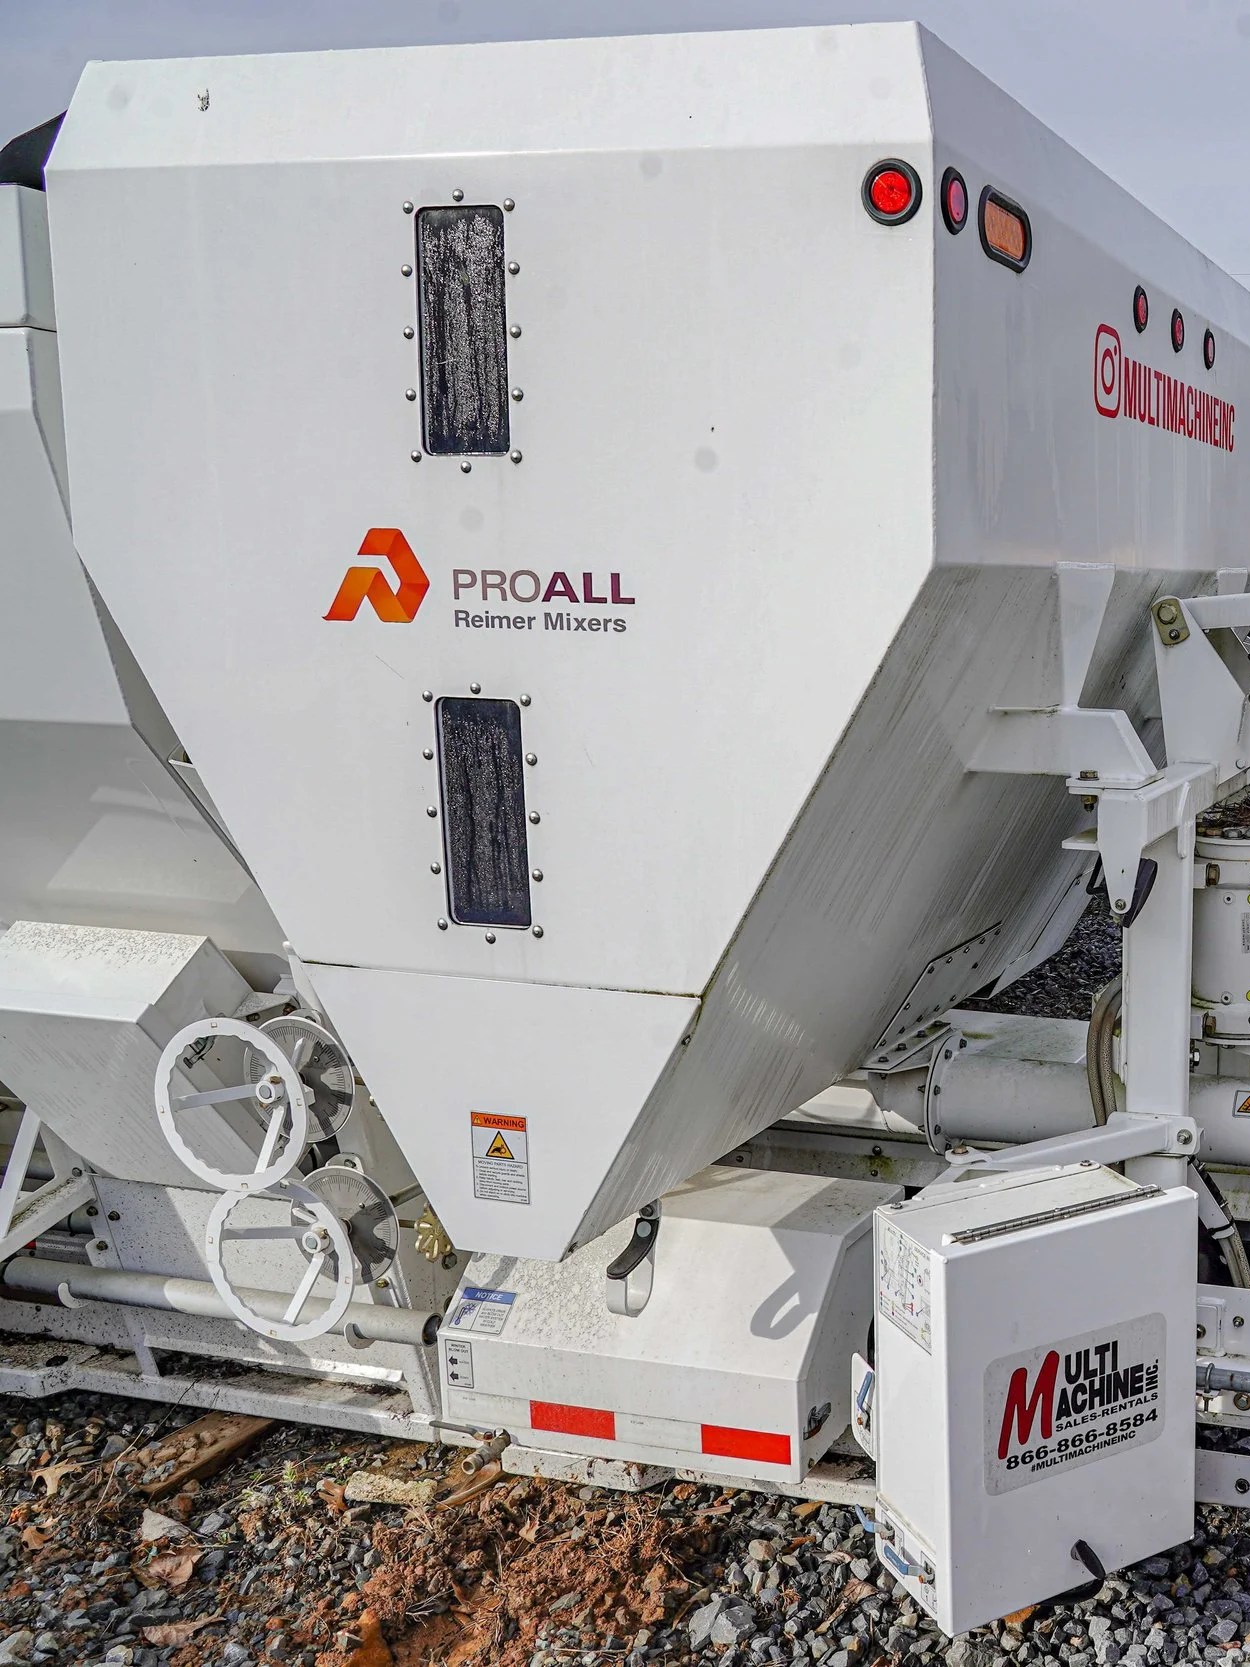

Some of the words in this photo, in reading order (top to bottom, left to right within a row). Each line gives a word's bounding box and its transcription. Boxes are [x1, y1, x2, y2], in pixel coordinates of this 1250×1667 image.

[1123, 356, 1235, 453] MULTIMACHINEINC
[452, 569, 636, 605] PROALL
[454, 609, 536, 630] Reimer
[544, 612, 627, 633] Mixers
[483, 1116, 525, 1129] WARNING
[475, 1291, 504, 1301] NOTICE
[1145, 1358, 1159, 1392] INC.
[1055, 1392, 1159, 1432] SALES-RENTALS
[1005, 1408, 1158, 1471] 866-866-8584
[1031, 1430, 1136, 1473] #MULTIMACHINEINC
